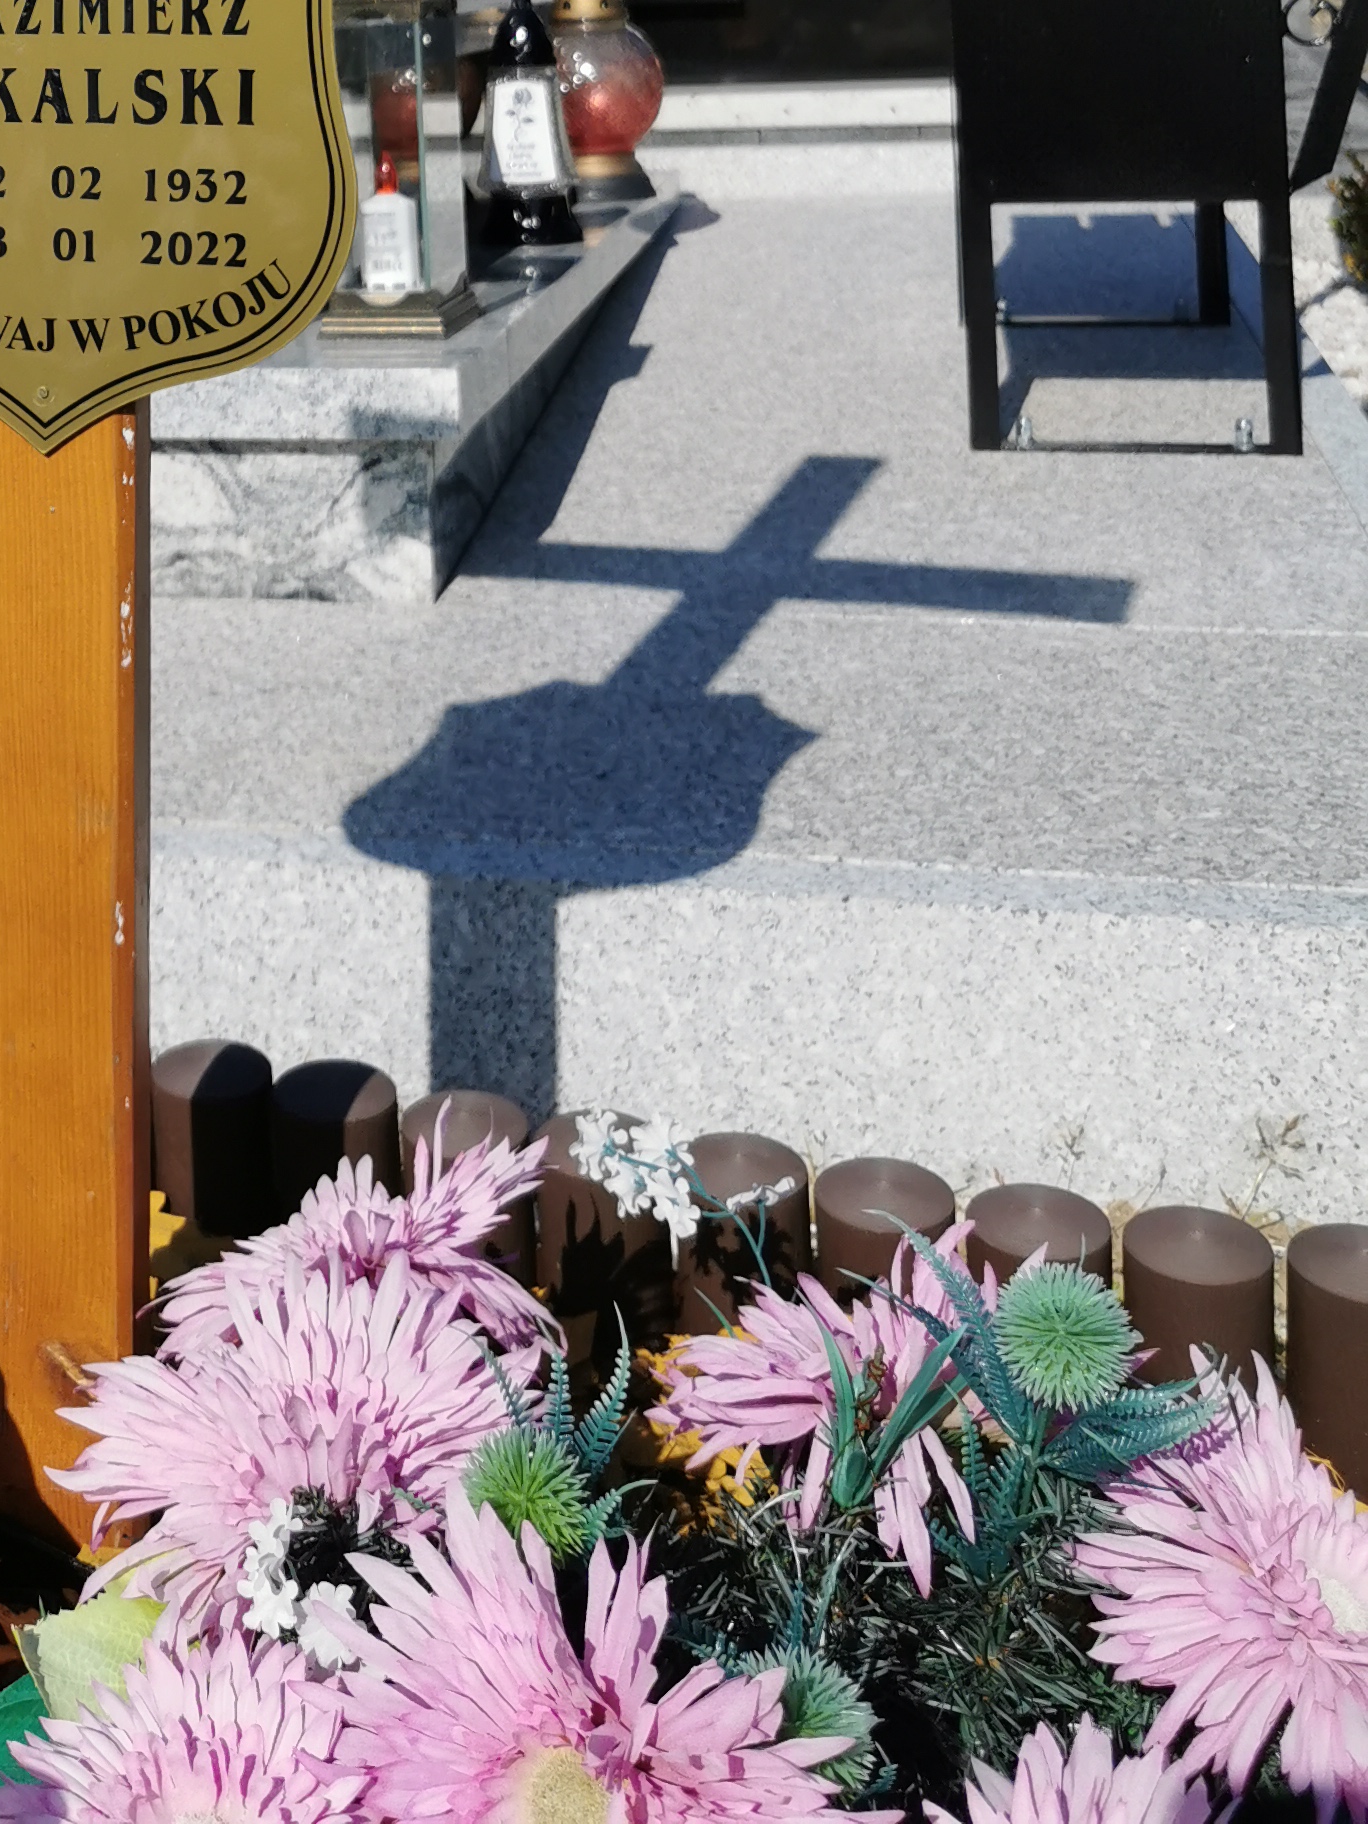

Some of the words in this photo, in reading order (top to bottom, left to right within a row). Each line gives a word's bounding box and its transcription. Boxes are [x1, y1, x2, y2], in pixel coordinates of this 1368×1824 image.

[50, 164, 103, 201] 02
[143, 167, 249, 206] 1932
[52, 227, 97, 263] 01
[139, 230, 249, 269] 2022
[67, 317, 111, 355] W
[118, 258, 292, 352] POKOJU
